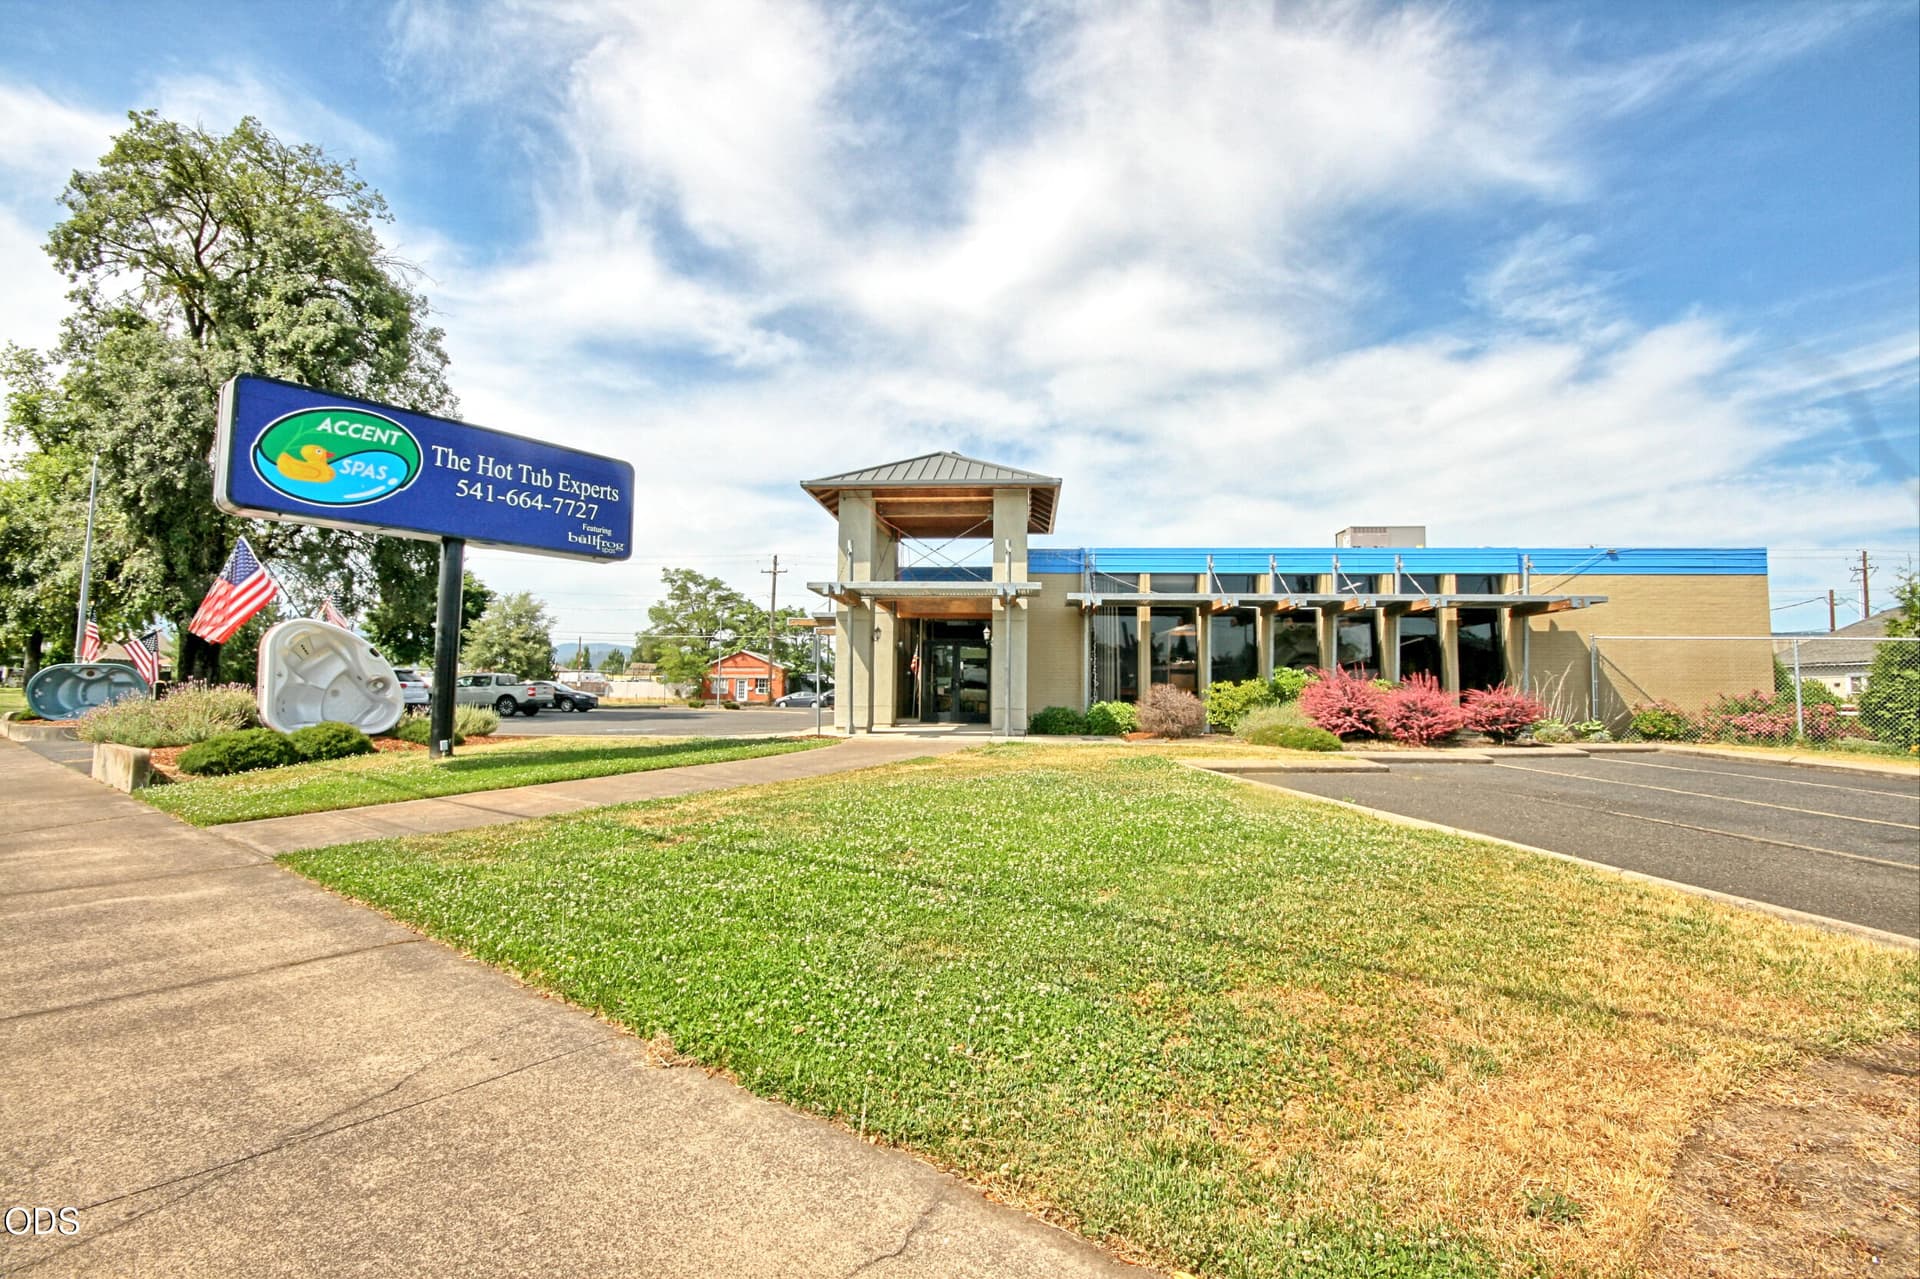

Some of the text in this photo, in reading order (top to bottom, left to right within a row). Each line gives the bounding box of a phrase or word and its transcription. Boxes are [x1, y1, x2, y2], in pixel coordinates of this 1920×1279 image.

[317, 417, 403, 446] ACCENT
[339, 459, 388, 481] SPAS
[432, 445, 619, 502] The Hot Tub Experts
[455, 479, 599, 520] 541-664-7727
[582, 523, 612, 536] Featuring
